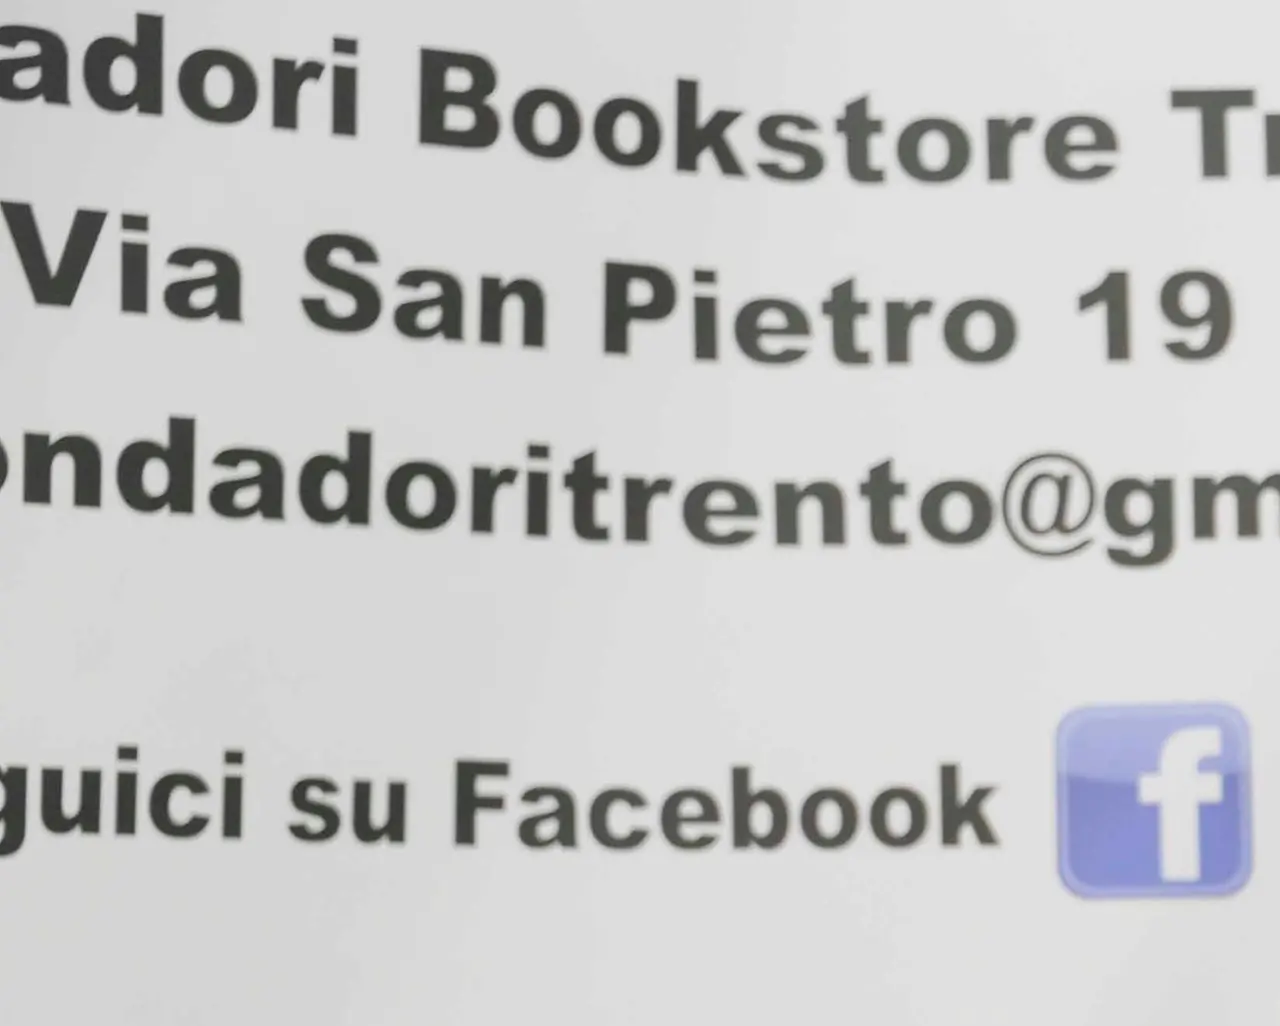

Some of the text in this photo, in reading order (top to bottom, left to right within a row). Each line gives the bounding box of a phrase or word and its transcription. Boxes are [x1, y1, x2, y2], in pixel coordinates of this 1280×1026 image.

[0, 12, 359, 138] adori
[417, 46, 1120, 185] Bookstore
[0, 199, 1234, 366] Via San Pietro 19
[287, 777, 408, 845] su
[454, 759, 1000, 851] Facebook
